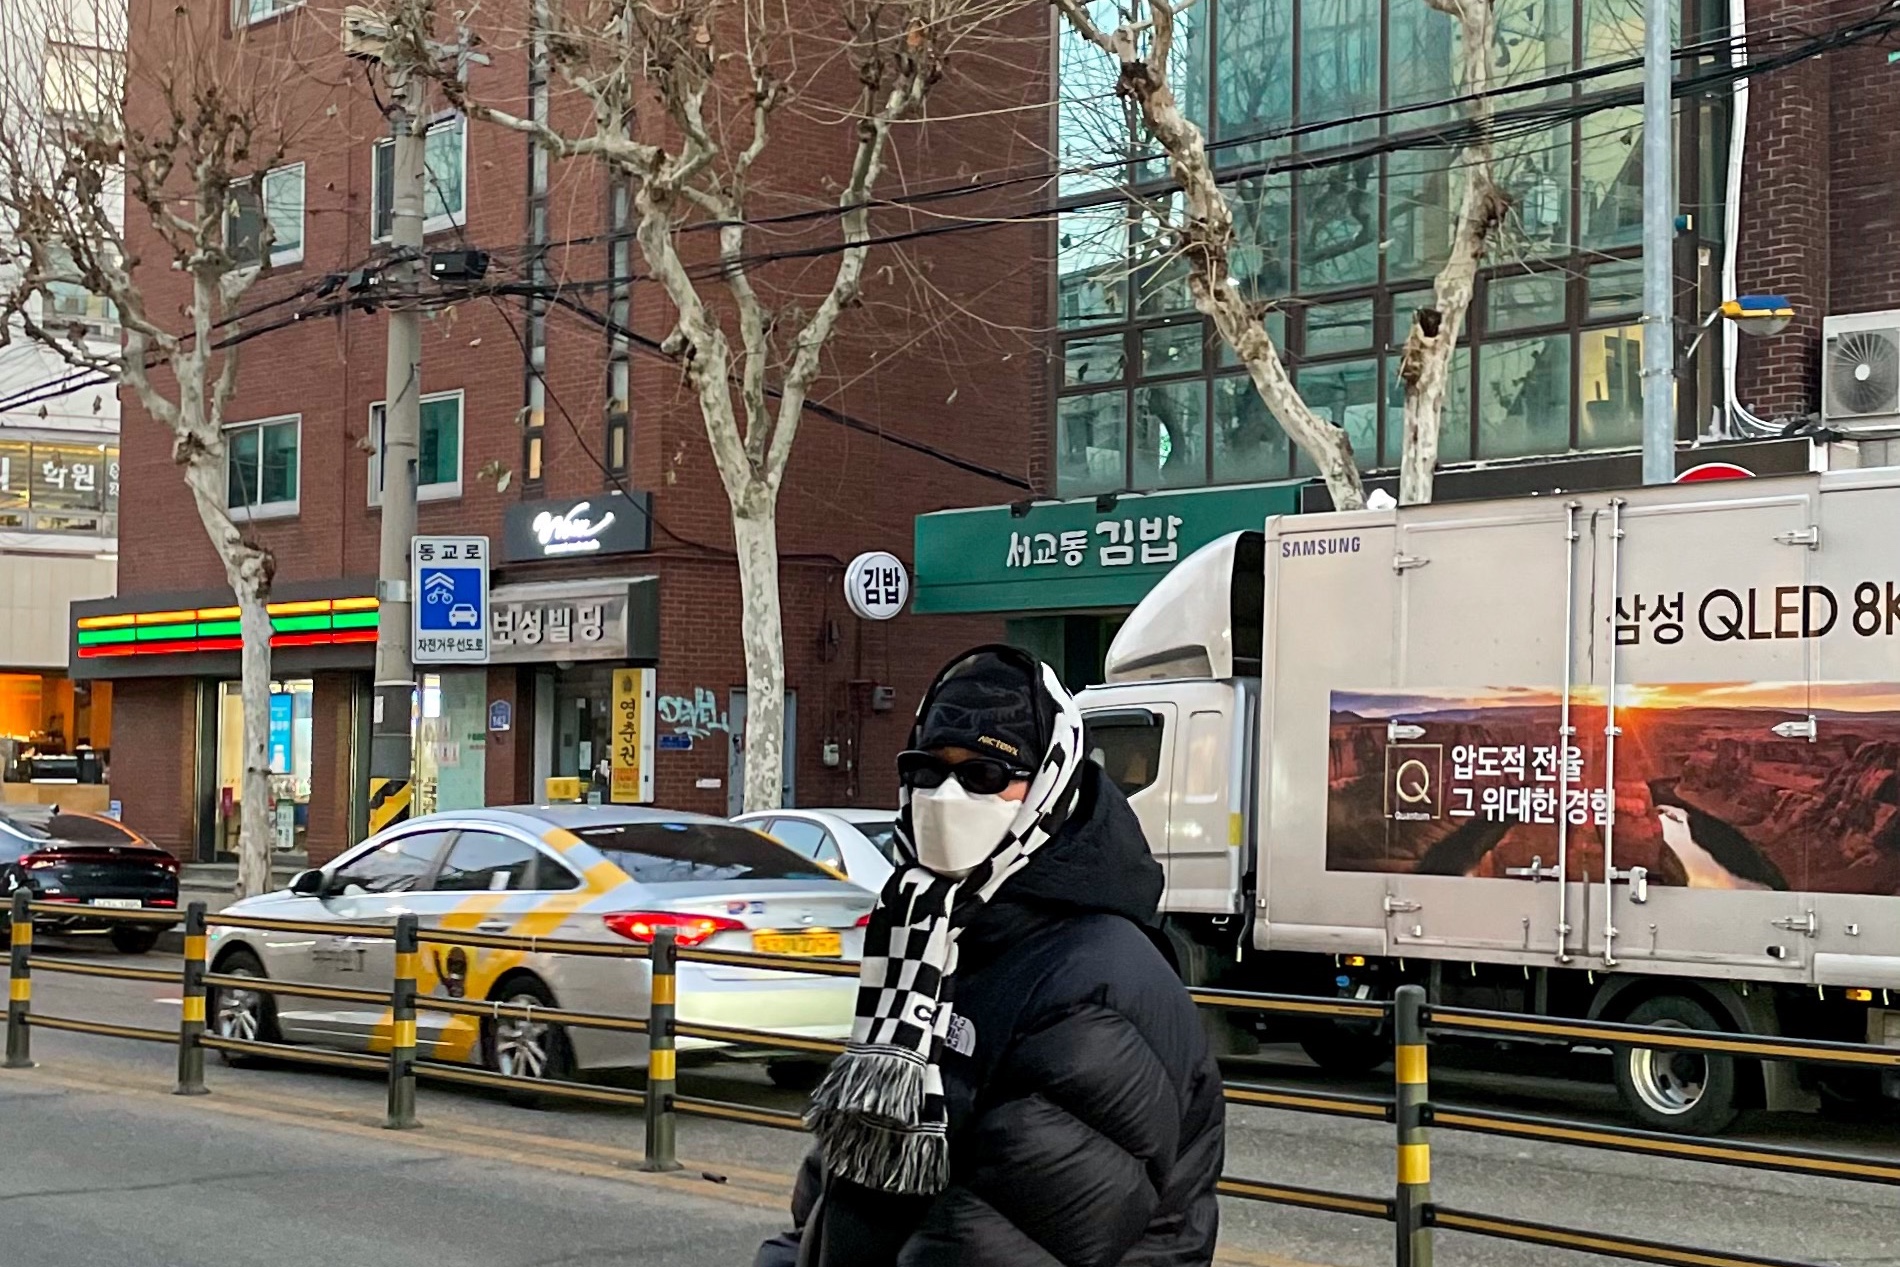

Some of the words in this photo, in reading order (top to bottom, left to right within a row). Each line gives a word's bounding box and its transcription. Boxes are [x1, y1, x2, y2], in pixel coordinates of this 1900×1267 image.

[42, 461, 95, 491] 학원
[418, 544, 482, 561] 동교로
[1006, 530, 1088, 568] 서교동
[1096, 515, 1183, 567] 김밥
[1282, 536, 1361, 558] SAMSUNG
[863, 567, 900, 605] 김밥
[492, 604, 604, 645] 보성빌딩
[1606, 592, 1684, 646] 삼성
[1698, 585, 1838, 642] QLED
[618, 698, 637, 767] 영춘권
[1396, 759, 1432, 804] Q
[1451, 745, 1525, 782] 압도적
[1531, 745, 1585, 782] 전율
[1449, 788, 1476, 816] 그
[1481, 786, 1558, 824] 위대한
[1565, 788, 1616, 825] 경험
